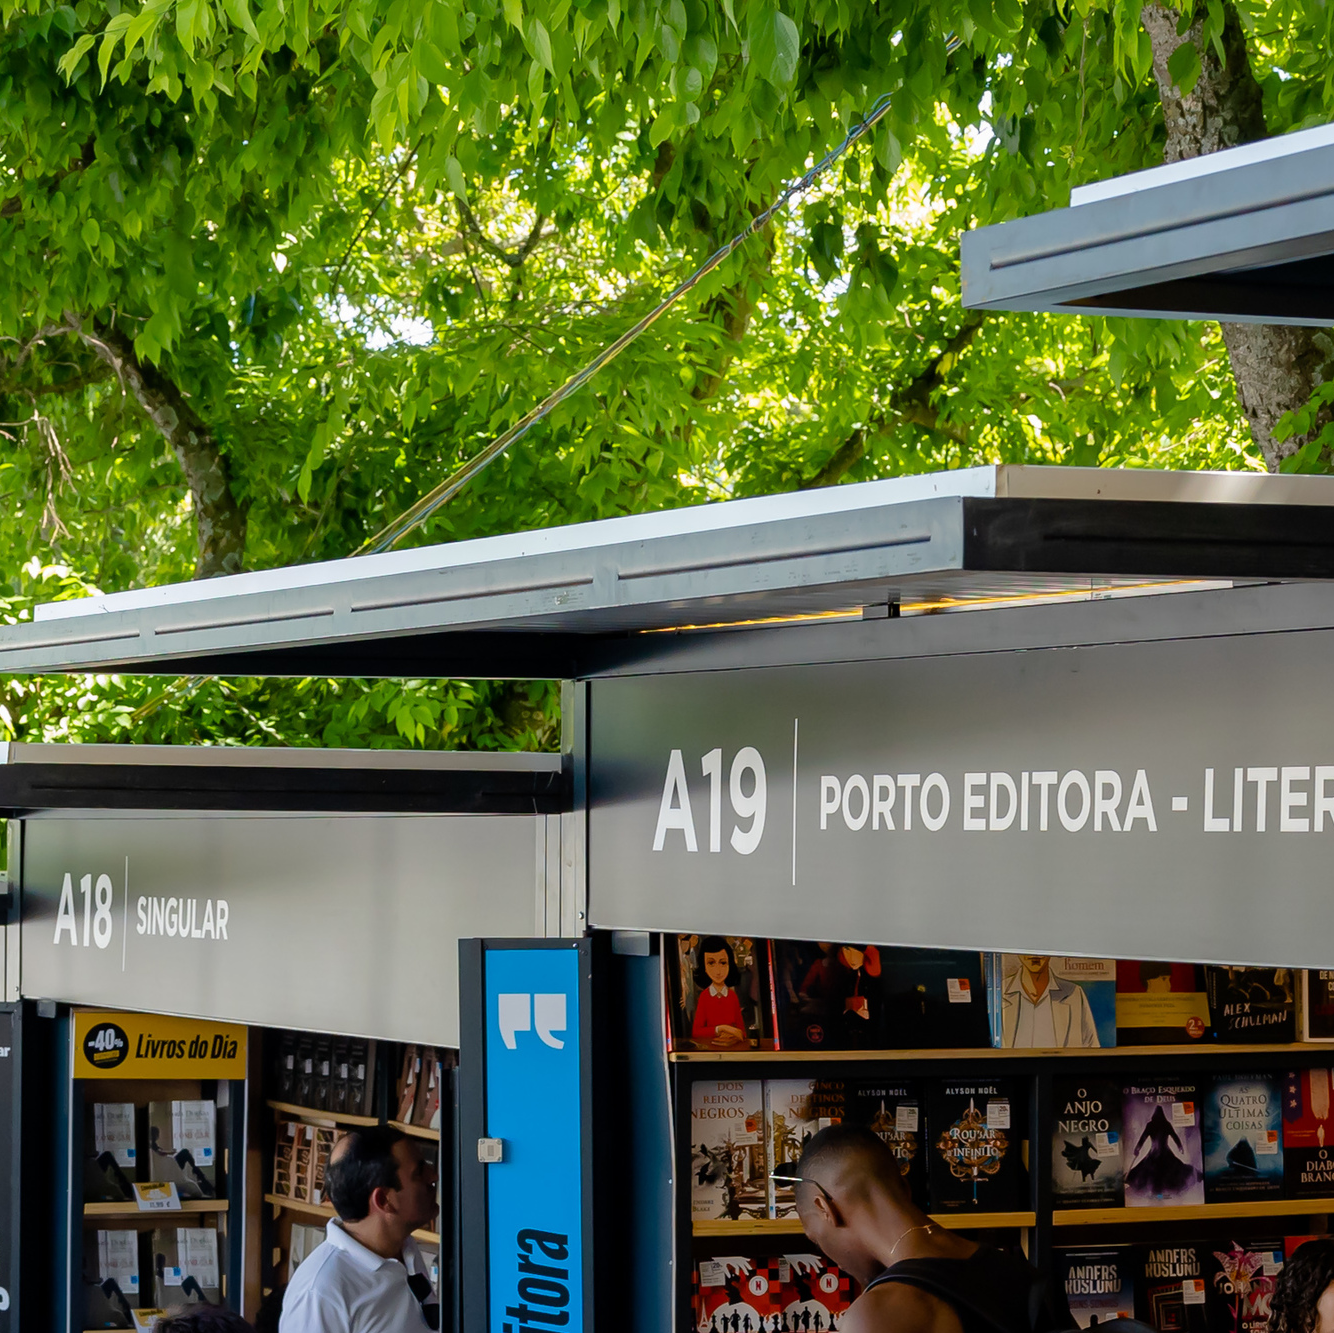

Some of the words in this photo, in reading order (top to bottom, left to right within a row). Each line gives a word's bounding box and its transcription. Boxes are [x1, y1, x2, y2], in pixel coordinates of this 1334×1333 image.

[652, 746, 768, 855] A19
[820, 773, 949, 831] PORTO
[964, 769, 1157, 833] EDITORA
[1172, 797, 1189, 811] -
[53, 873, 113, 949] A18
[136, 896, 229, 941] SINGULAR
[1223, 1002, 1251, 1017] ALEX
[1228, 1010, 1287, 1031] SCHULMAN
[88, 1028, 124, 1051] -40%
[135, 1033, 186, 1059] Livros
[188, 1034, 209, 1059] do
[210, 1034, 238, 1059] Dia
[717, 1082, 744, 1091] DOIS
[858, 1089, 886, 1097] ALYSON
[945, 1087, 976, 1095] ALYSON
[978, 1086, 998, 1094] NOËL
[1077, 1088, 1087, 1099] O
[1131, 1086, 1156, 1096] BRAÇO
[1239, 1086, 1249, 1094] AS
[703, 1095, 744, 1104] REINOS
[1220, 1094, 1267, 1109] QUATRO
[691, 1107, 745, 1119] NEGROS
[1063, 1100, 1103, 1117] ANJO
[1058, 1119, 1109, 1133] NEGRO
[1226, 1121, 1263, 1130] COISAS
[1318, 1149, 1328, 1159] O
[1148, 1248, 1197, 1263] ANDERS
[1068, 1264, 1118, 1280] ANDERS
[1145, 1262, 1201, 1279] ROSLUND
[1064, 1278, 1122, 1295] ROSLUND
